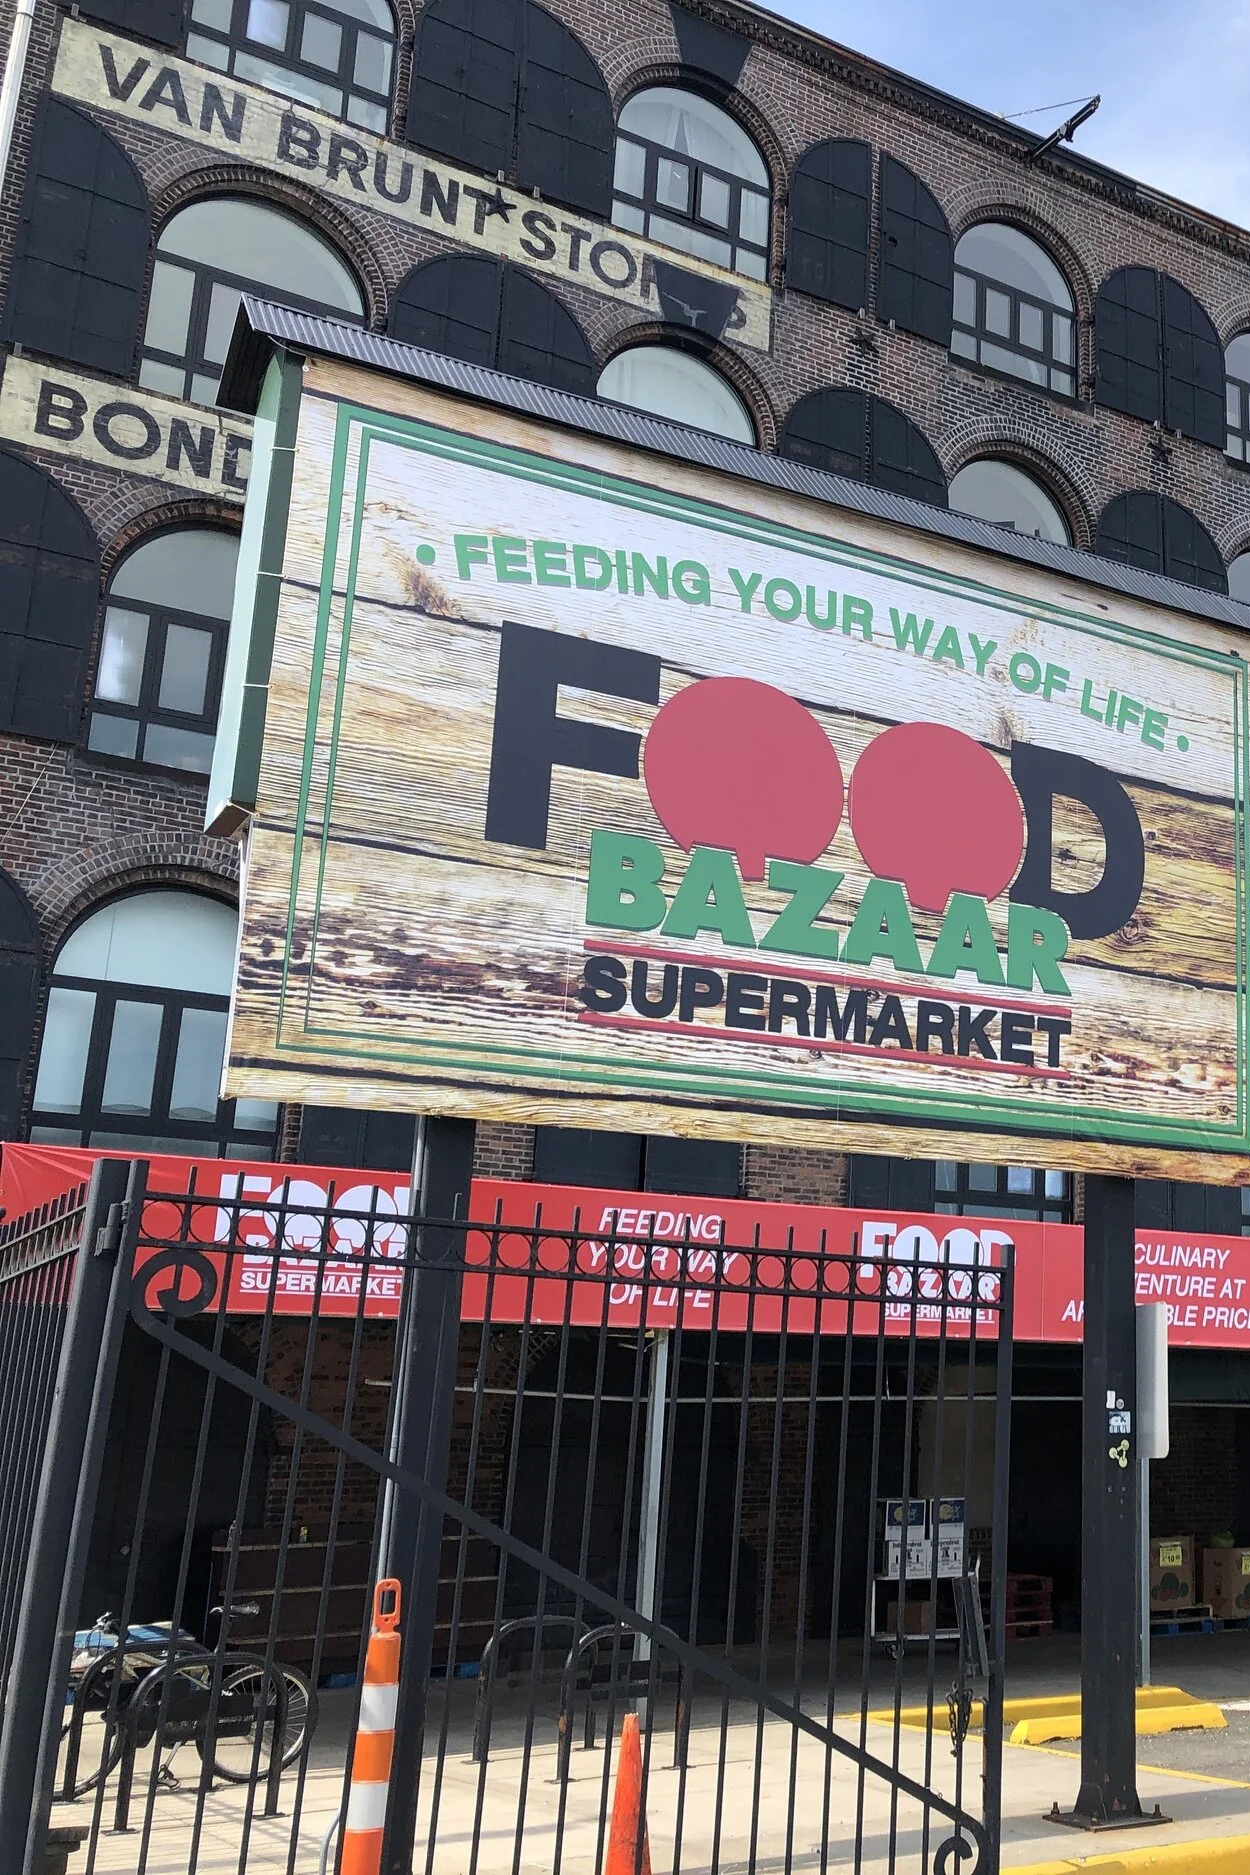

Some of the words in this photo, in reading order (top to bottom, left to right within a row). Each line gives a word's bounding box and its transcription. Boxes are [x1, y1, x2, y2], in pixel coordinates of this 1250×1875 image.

[99, 44, 245, 142] VAN
[276, 107, 499, 235] BRUNT
[454, 534, 711, 607] FEEDING
[728, 567, 873, 642] YOUR
[889, 607, 997, 676] WAY
[1009, 651, 1070, 700] OF
[1080, 677, 1169, 752] LIFE
[484, 620, 1145, 942] FOOD
[586, 829, 1072, 997] BAZAAR
[581, 956, 1071, 1068] SUPERMARKET
[589, 1241, 669, 1271] YOUR
[598, 1207, 721, 1240] FEEDING
[1135, 1243, 1230, 1269] CULINARY
[1219, 1278, 1246, 1300] AT
